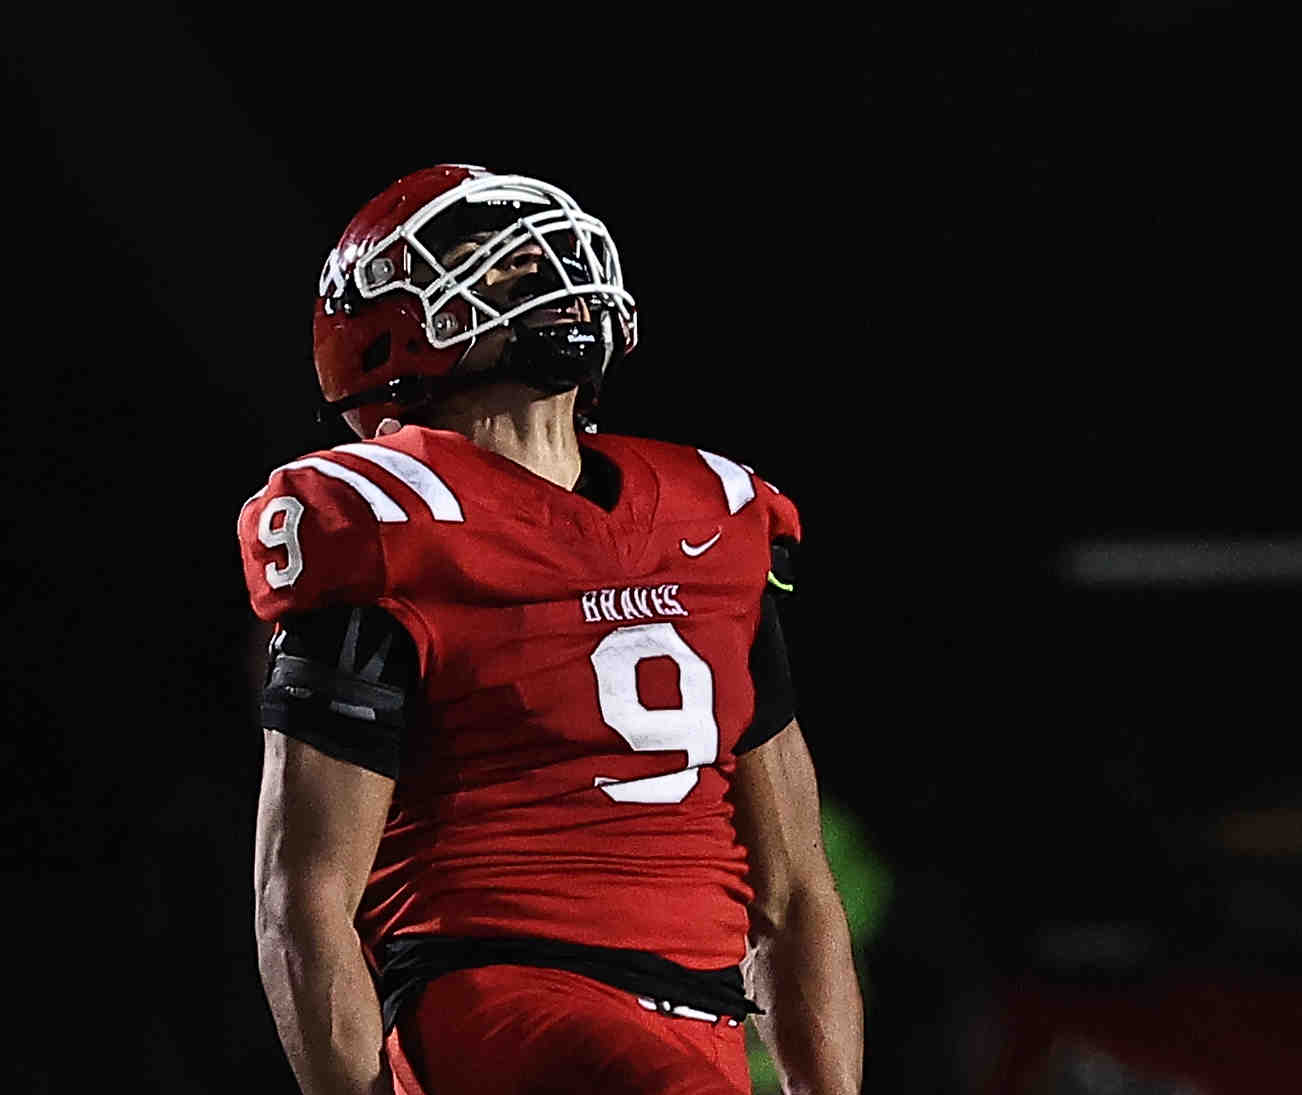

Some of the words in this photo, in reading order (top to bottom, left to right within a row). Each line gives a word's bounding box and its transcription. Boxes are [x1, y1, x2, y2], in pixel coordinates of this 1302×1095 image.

[258, 495, 304, 590] 9
[582, 584, 688, 622] BRAVES
[590, 622, 719, 804] 9
